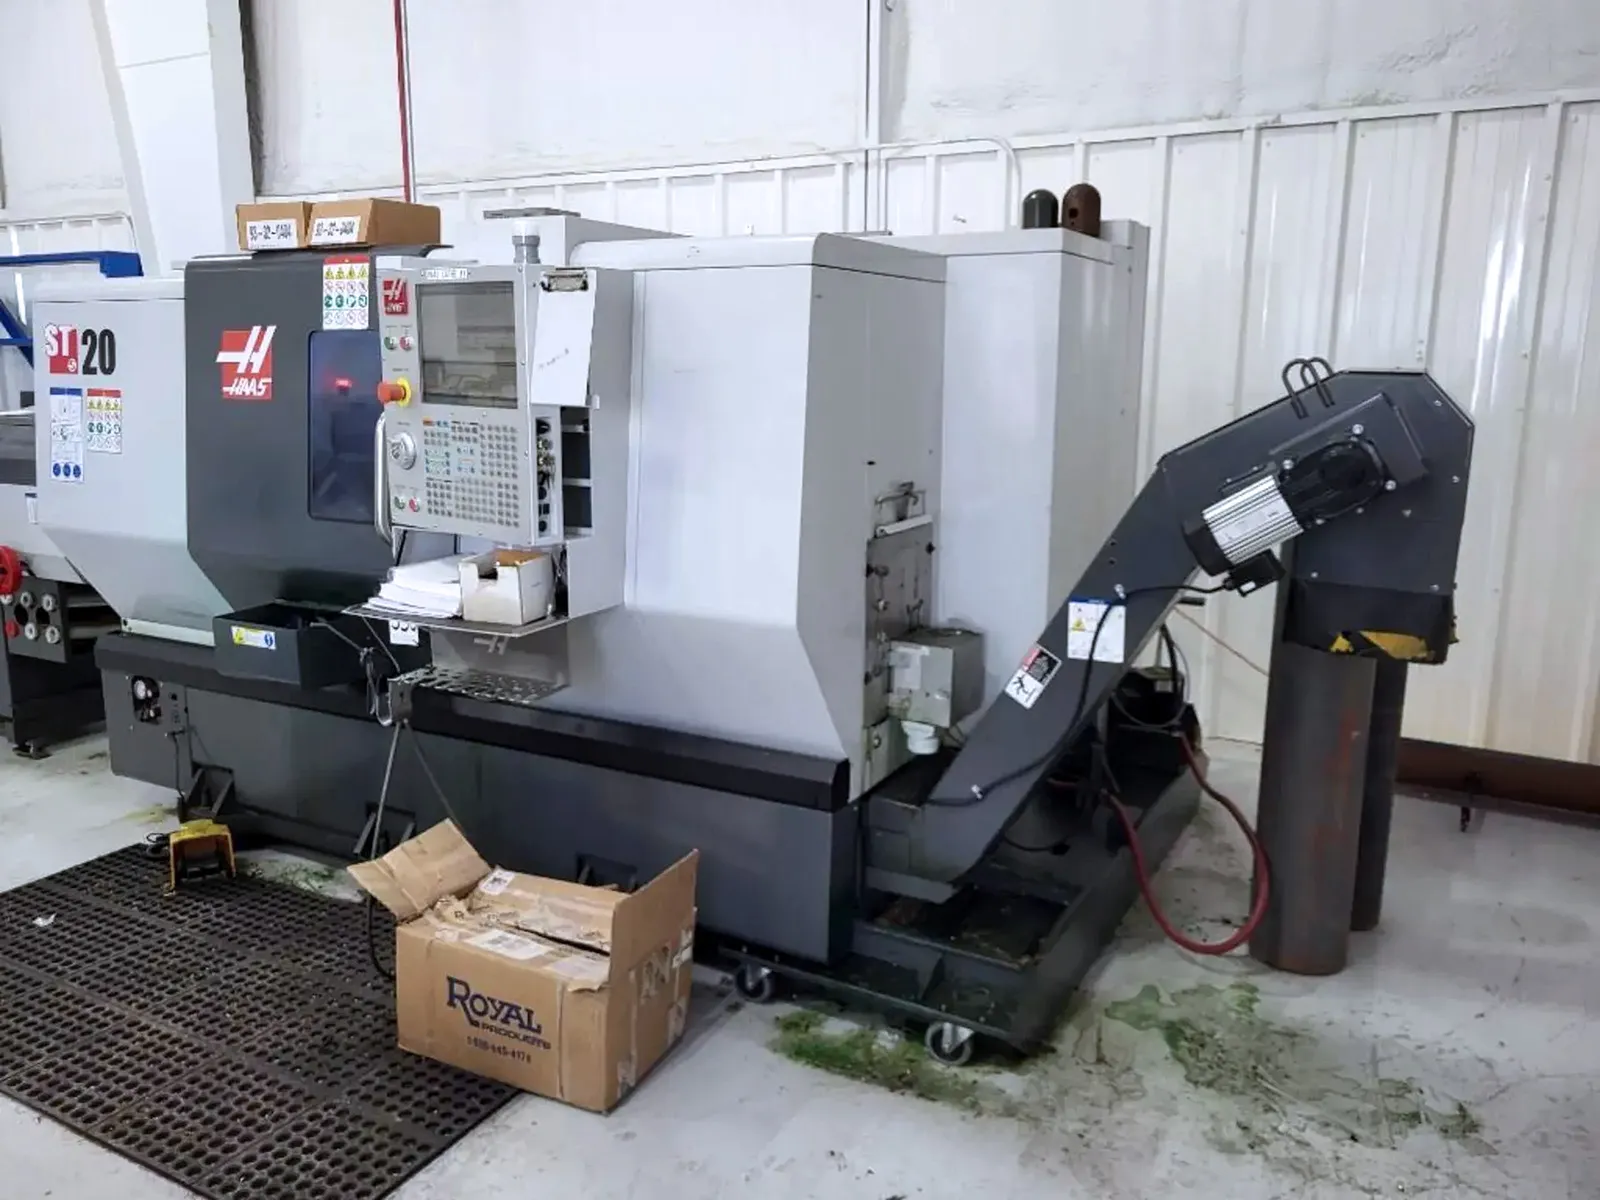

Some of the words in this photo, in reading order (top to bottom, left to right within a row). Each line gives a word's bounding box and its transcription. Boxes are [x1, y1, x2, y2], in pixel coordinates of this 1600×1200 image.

[45, 323, 73, 356] ST
[82, 328, 116, 375] 20
[223, 377, 272, 396] HAAS
[446, 975, 542, 1034] ROYAL
